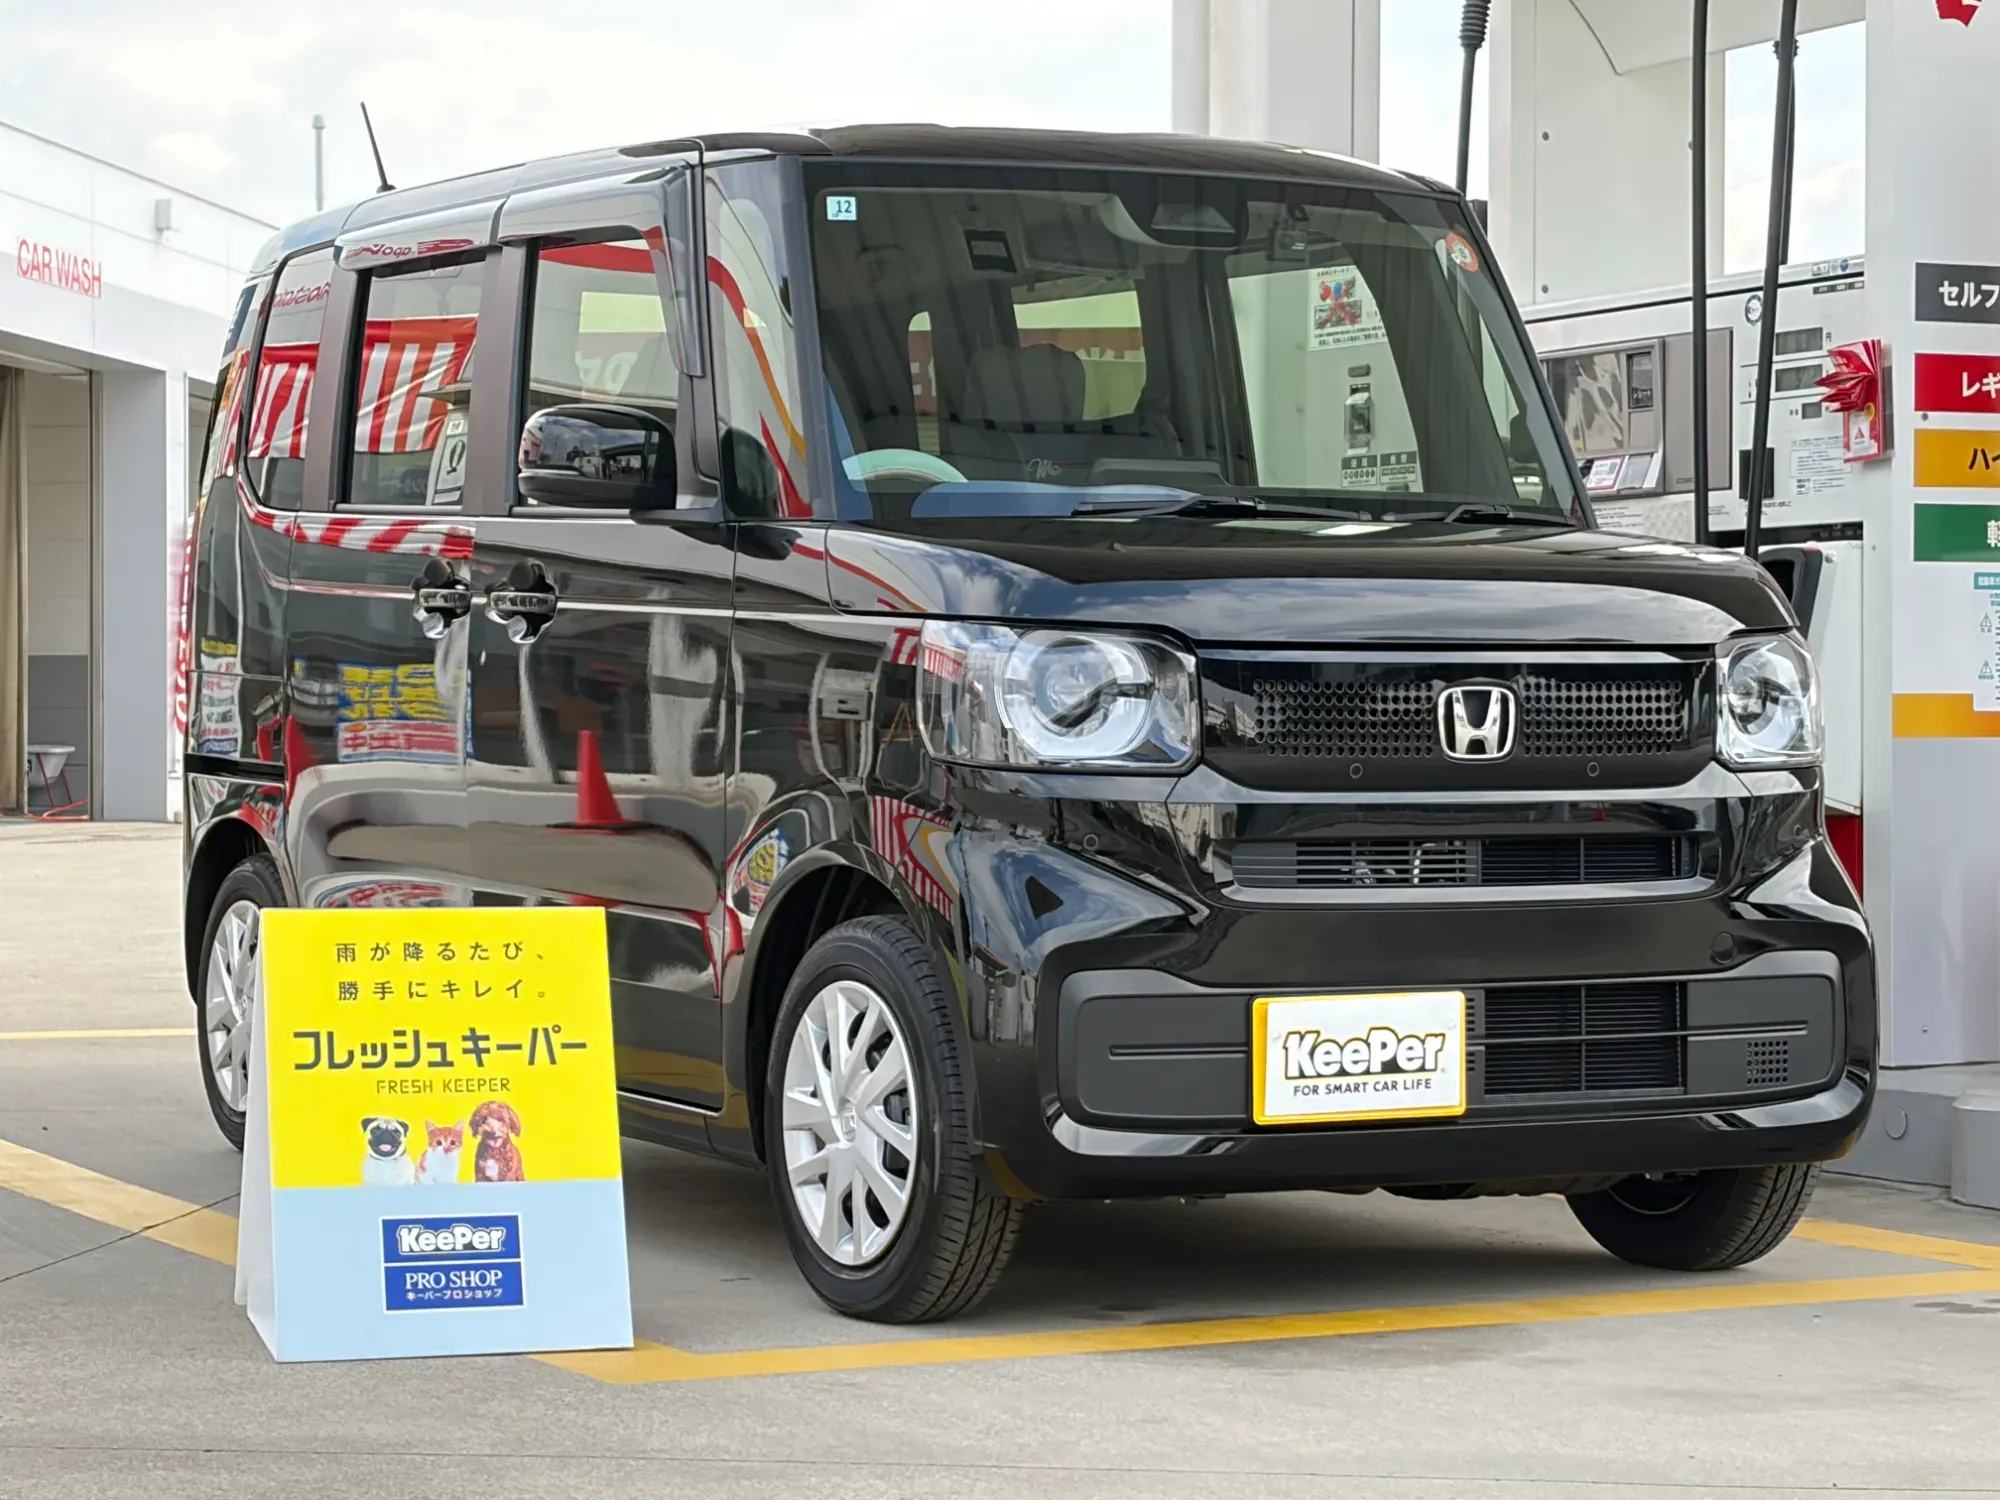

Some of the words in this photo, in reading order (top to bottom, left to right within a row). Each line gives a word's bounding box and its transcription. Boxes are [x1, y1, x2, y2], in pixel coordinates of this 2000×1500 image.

[836, 200, 852, 213] 12
[17, 239, 52, 283] CAR
[55, 248, 101, 299] WASH
[1938, 280, 2000, 308] セルフ
[335, 941, 544, 963] 雨が降るたび、
[337, 979, 547, 1001] 勝手にキレイ。
[293, 1024, 588, 1071] フレッシュキーパー
[1283, 1026, 1446, 1080] KeePer
[376, 1079, 434, 1095] FRESH
[442, 1077, 511, 1093] KEEPER
[1293, 1082, 1320, 1097] FOR
[1324, 1081, 1369, 1095] SMART
[1373, 1080, 1398, 1092] CAR
[1403, 1078, 1432, 1090] LIFE
[397, 1224, 506, 1255] KeePer
[405, 1272, 446, 1289] PRO
[450, 1270, 503, 1288] SHOP
[406, 1288, 503, 1301] キーパープロショップ
